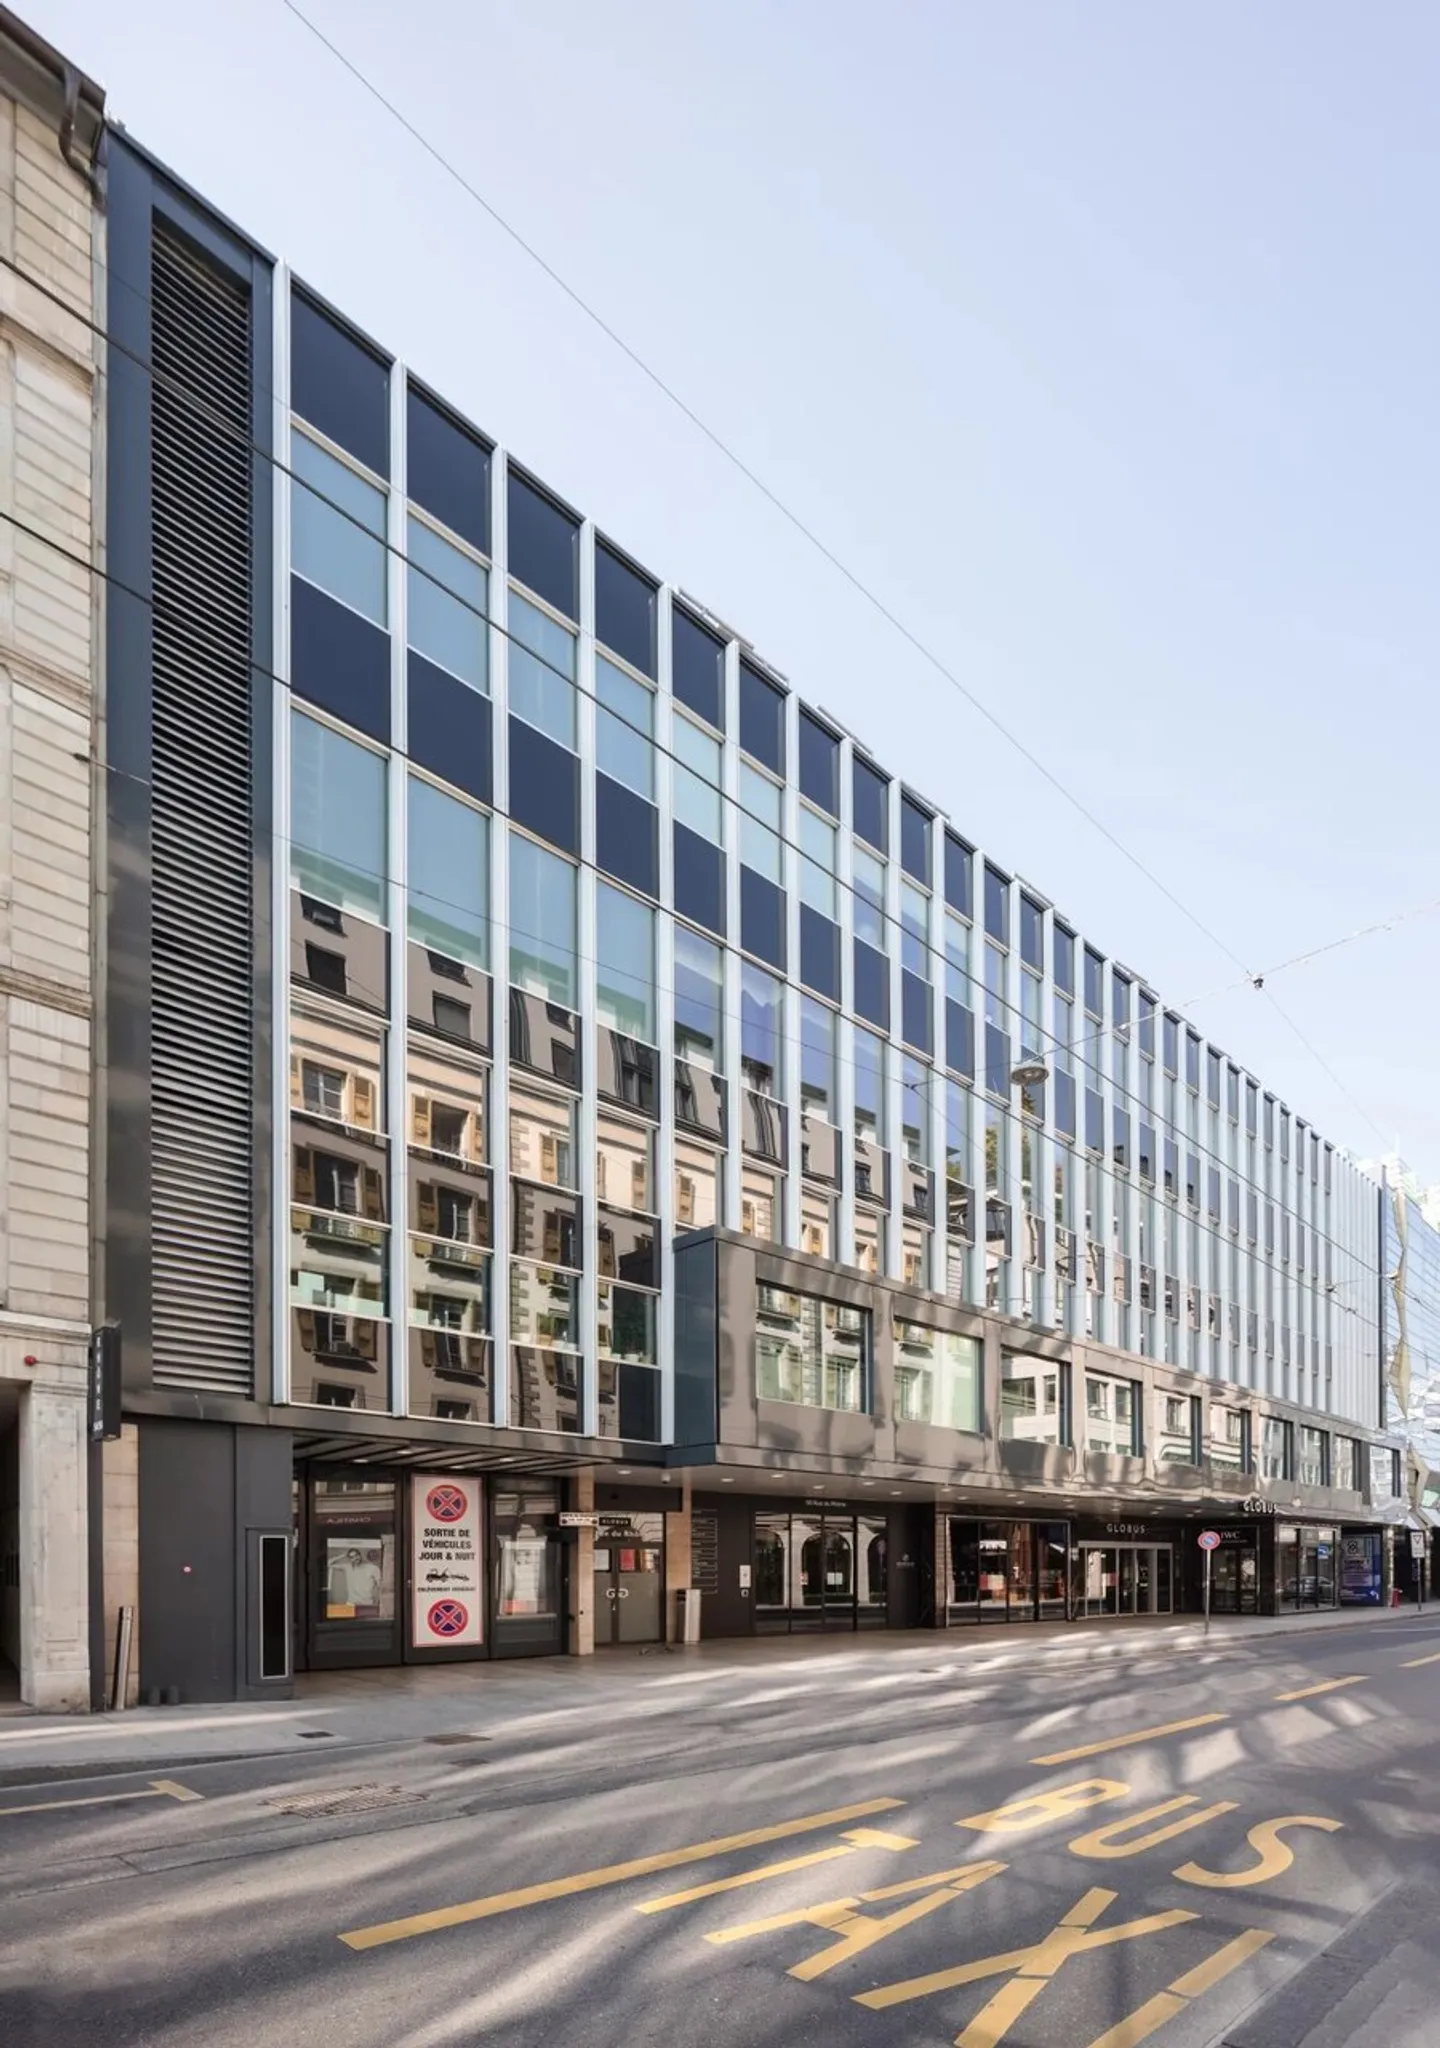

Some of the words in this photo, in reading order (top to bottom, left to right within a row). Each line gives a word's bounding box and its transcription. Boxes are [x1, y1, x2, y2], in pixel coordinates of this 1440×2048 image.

[424, 1528, 456, 1537] SORTIE
[458, 1529, 470, 1537] DE
[1106, 1523, 1146, 1534] GLOBUS
[1220, 1531, 1240, 1539] IWC
[422, 1539, 472, 1549] VÉHICULES
[419, 1552, 443, 1560] JOUR
[446, 1552, 453, 1560] &
[455, 1552, 475, 1560] NUIT
[955, 1778, 1345, 1888] BUS
[634, 1826, 1278, 2048] TAXI
